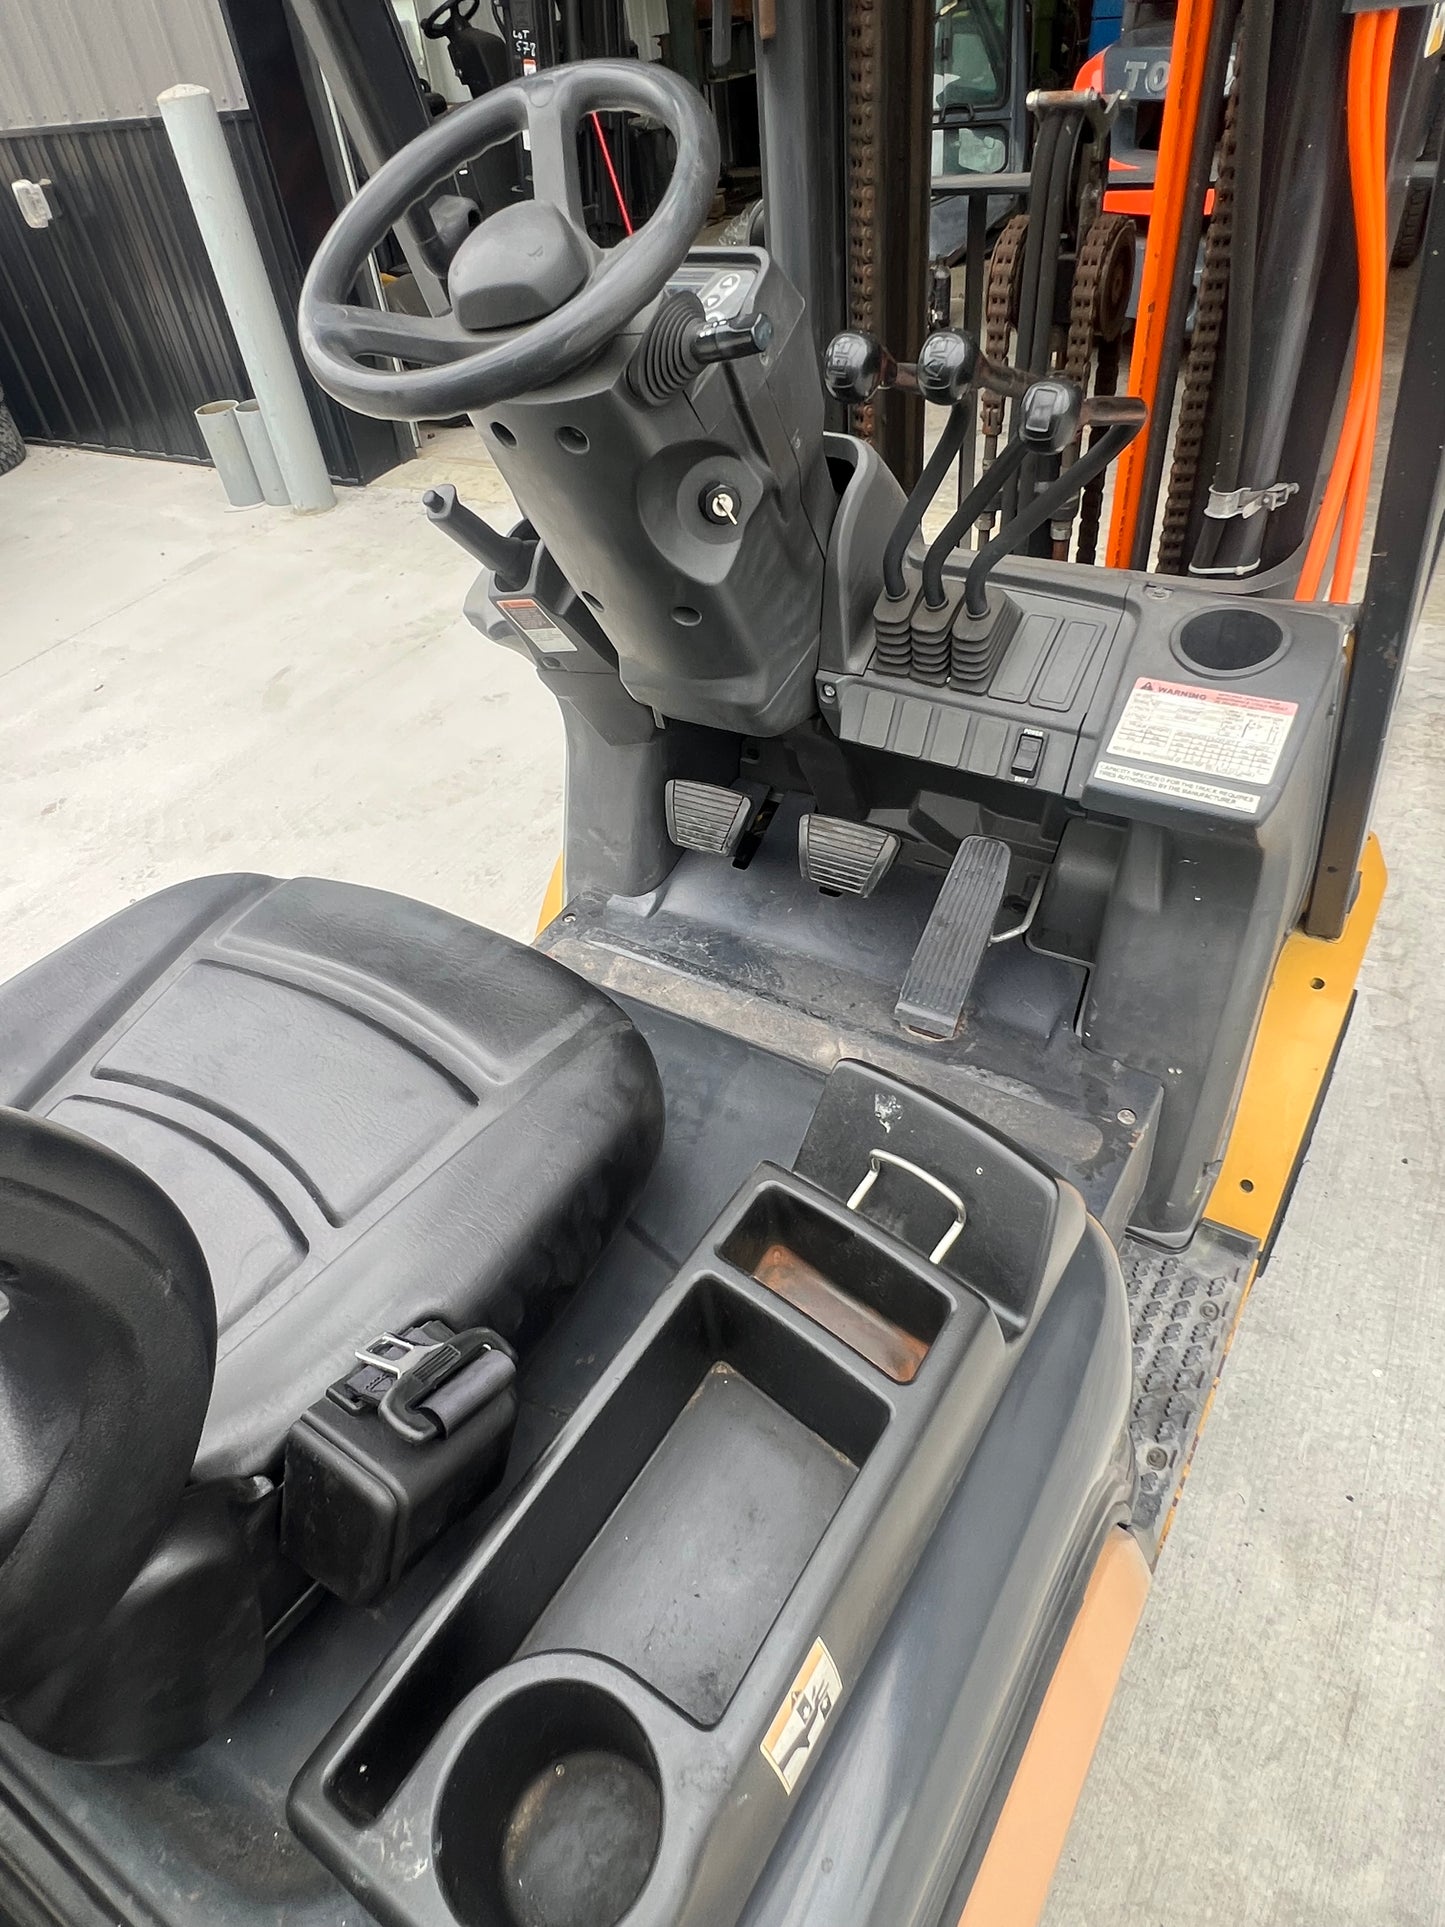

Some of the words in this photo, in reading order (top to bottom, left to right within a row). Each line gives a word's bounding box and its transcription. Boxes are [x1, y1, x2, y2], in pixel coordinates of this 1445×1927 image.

[512, 29, 530, 39] LOT
[1158, 686, 1207, 700] WARNING
[1023, 728, 1044, 737] POWER
[1099, 769, 1116, 778] TIRES
[1117, 774, 1158, 787] AUTHORIZED
[1181, 788, 1237, 804] MANUFACTURER
[1100, 764, 1131, 773] CAPACITY
[1132, 771, 1166, 783] SPECIFIED
[1195, 784, 1218, 793] TRUCK
[1218, 790, 1254, 803] REQUIRES
